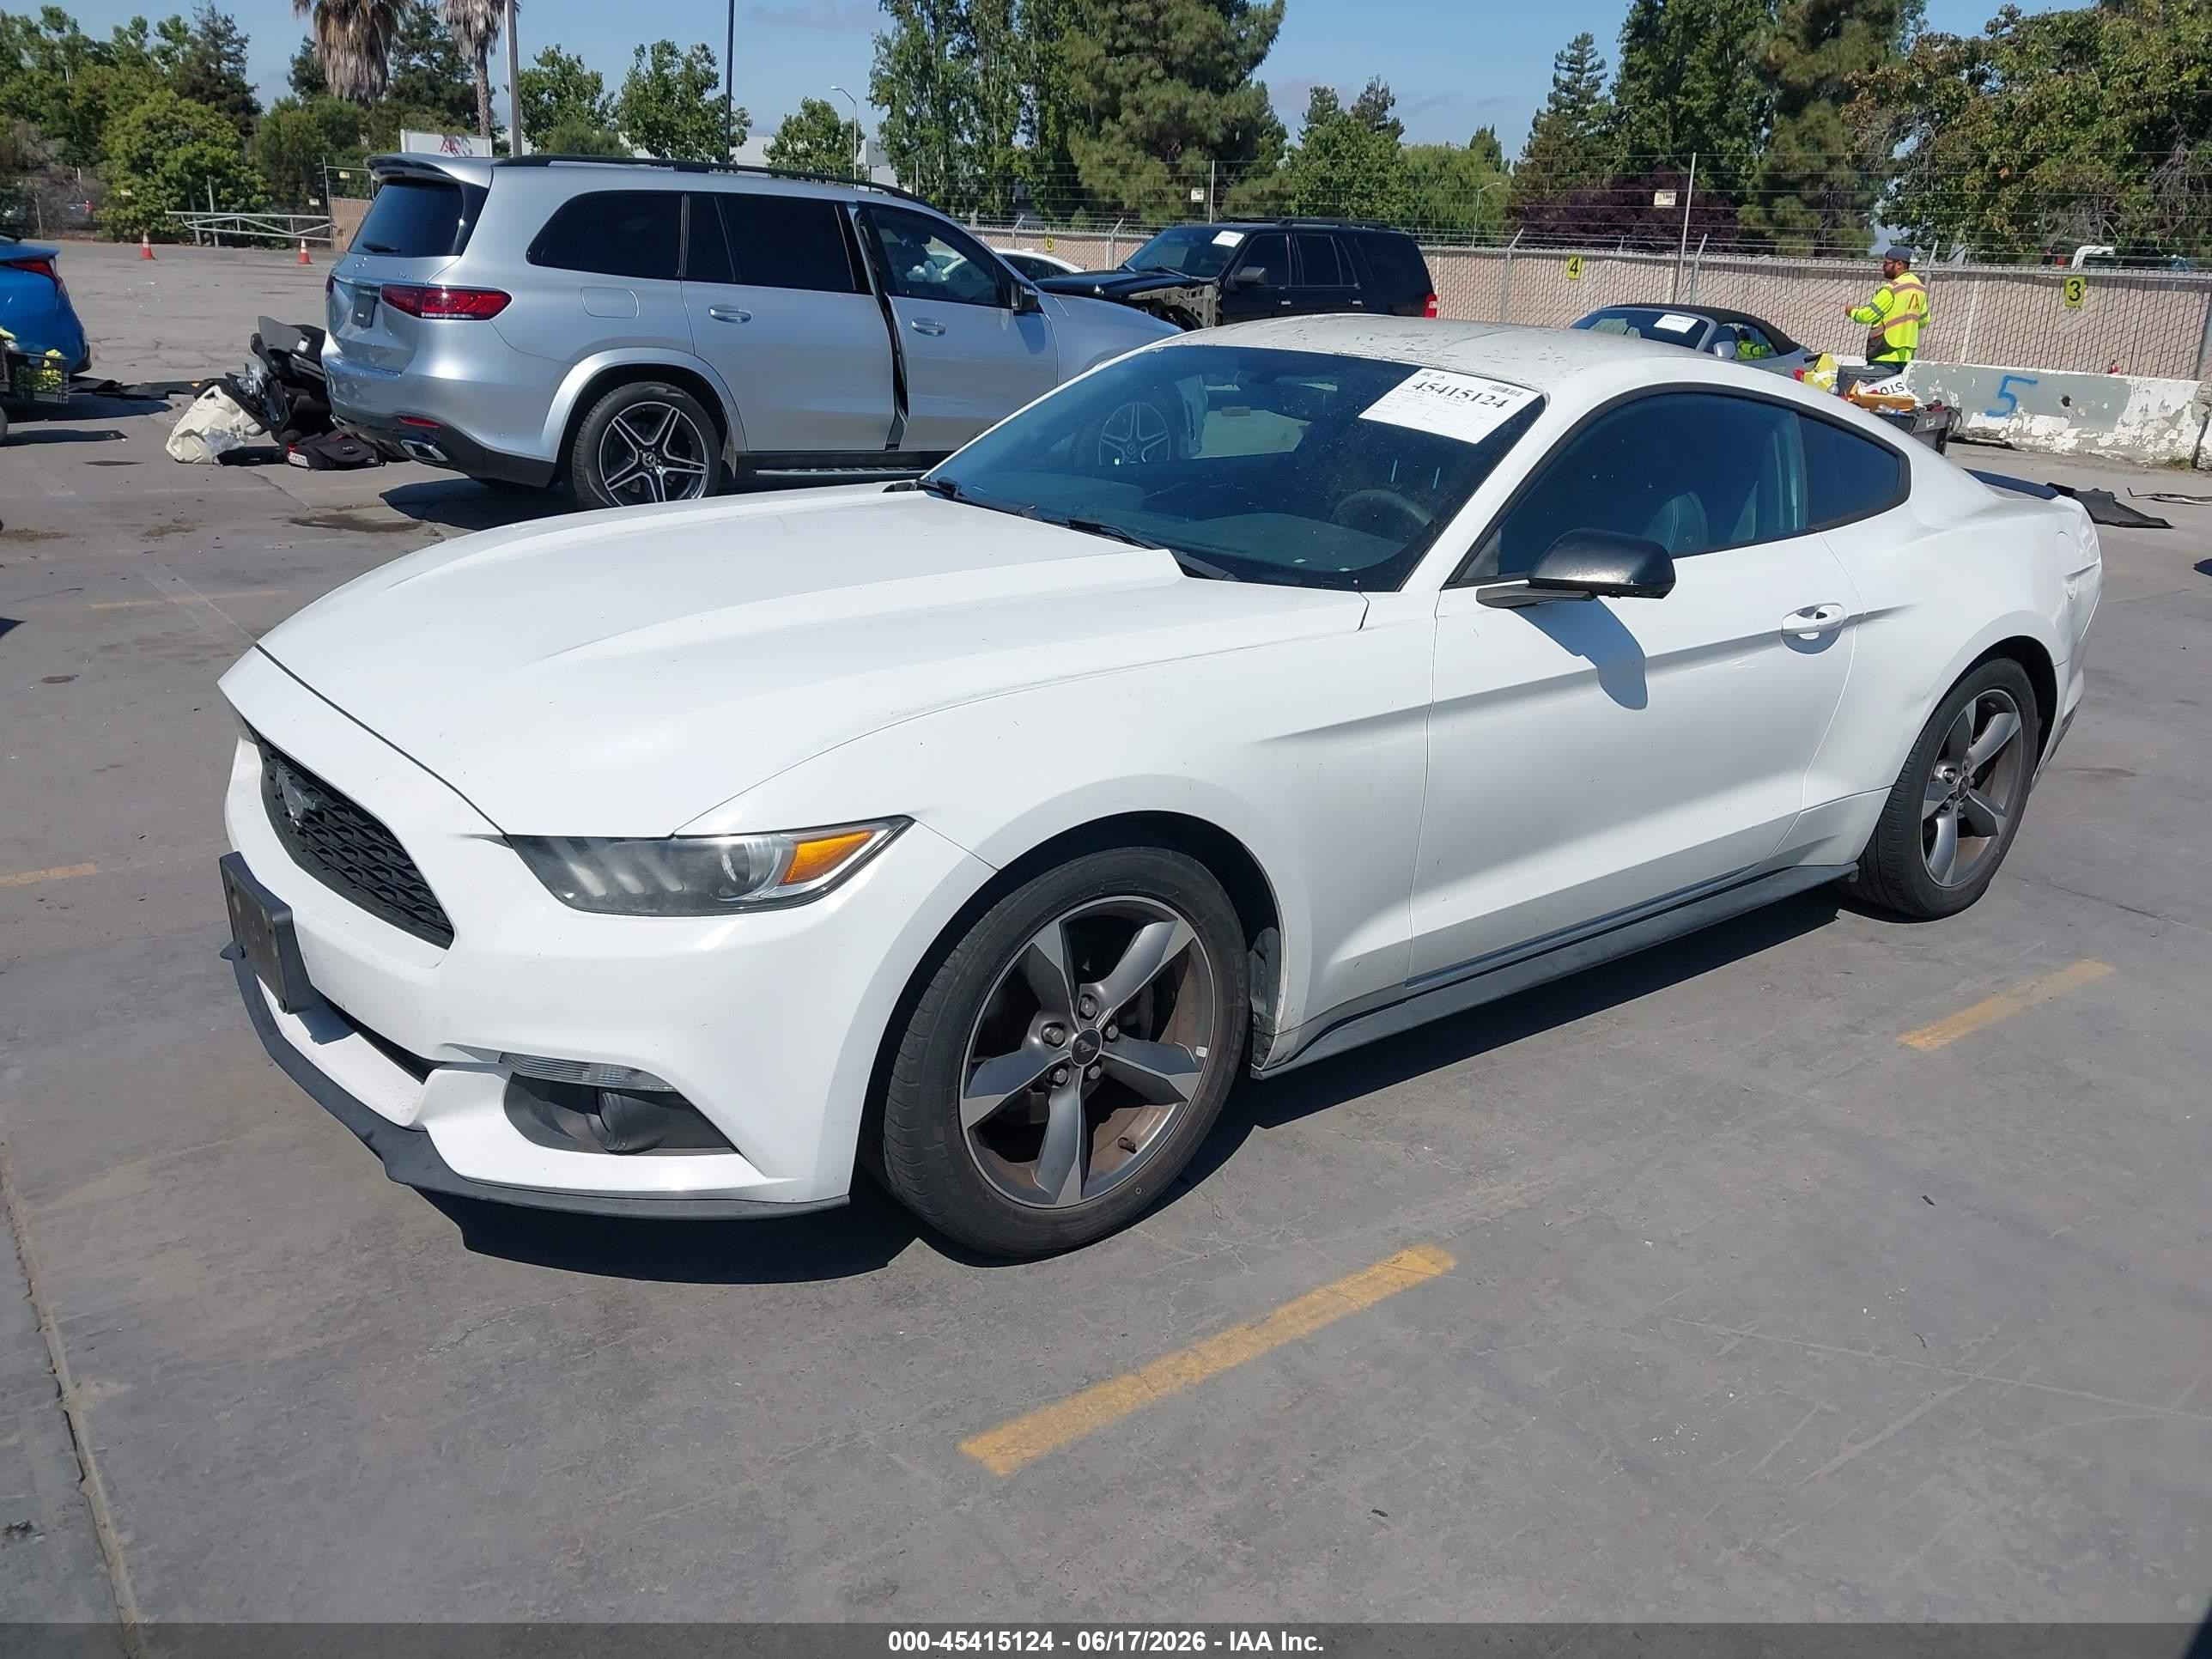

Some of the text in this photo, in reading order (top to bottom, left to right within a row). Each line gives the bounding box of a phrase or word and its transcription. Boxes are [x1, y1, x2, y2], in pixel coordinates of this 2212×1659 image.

[1047, 234, 1053, 249] 6
[1569, 257, 1579, 276] 4
[2068, 280, 2081, 302] 3
[1412, 380, 1510, 409] 45415124
[1985, 374, 2039, 417] 5
